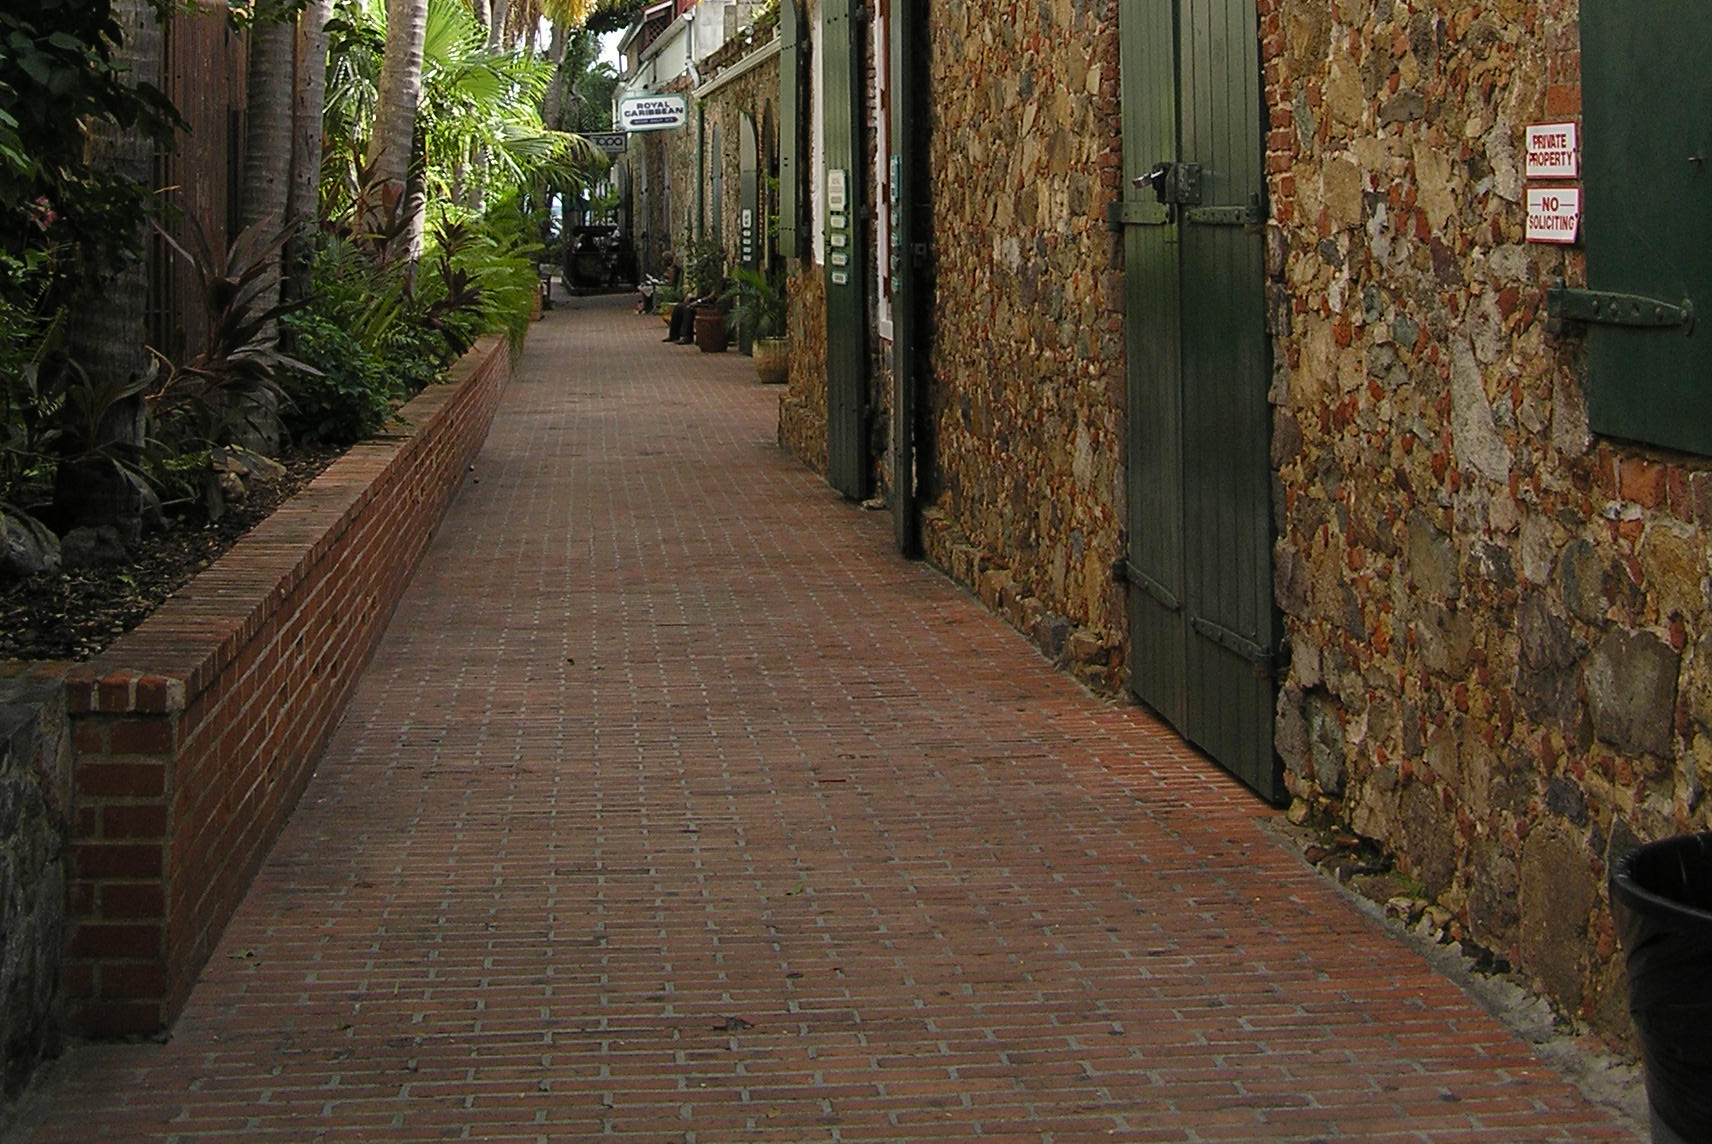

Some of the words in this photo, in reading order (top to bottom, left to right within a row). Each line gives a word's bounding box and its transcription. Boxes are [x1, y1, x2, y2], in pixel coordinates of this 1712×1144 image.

[624, 107, 684, 117] CARIBBEAN
[636, 101, 670, 109] ROYAL
[1532, 134, 1567, 149] PRIVATE
[1528, 152, 1572, 166] PROPERTY
[1542, 197, 1559, 211] NO
[1528, 215, 1574, 230] SOLICITING
